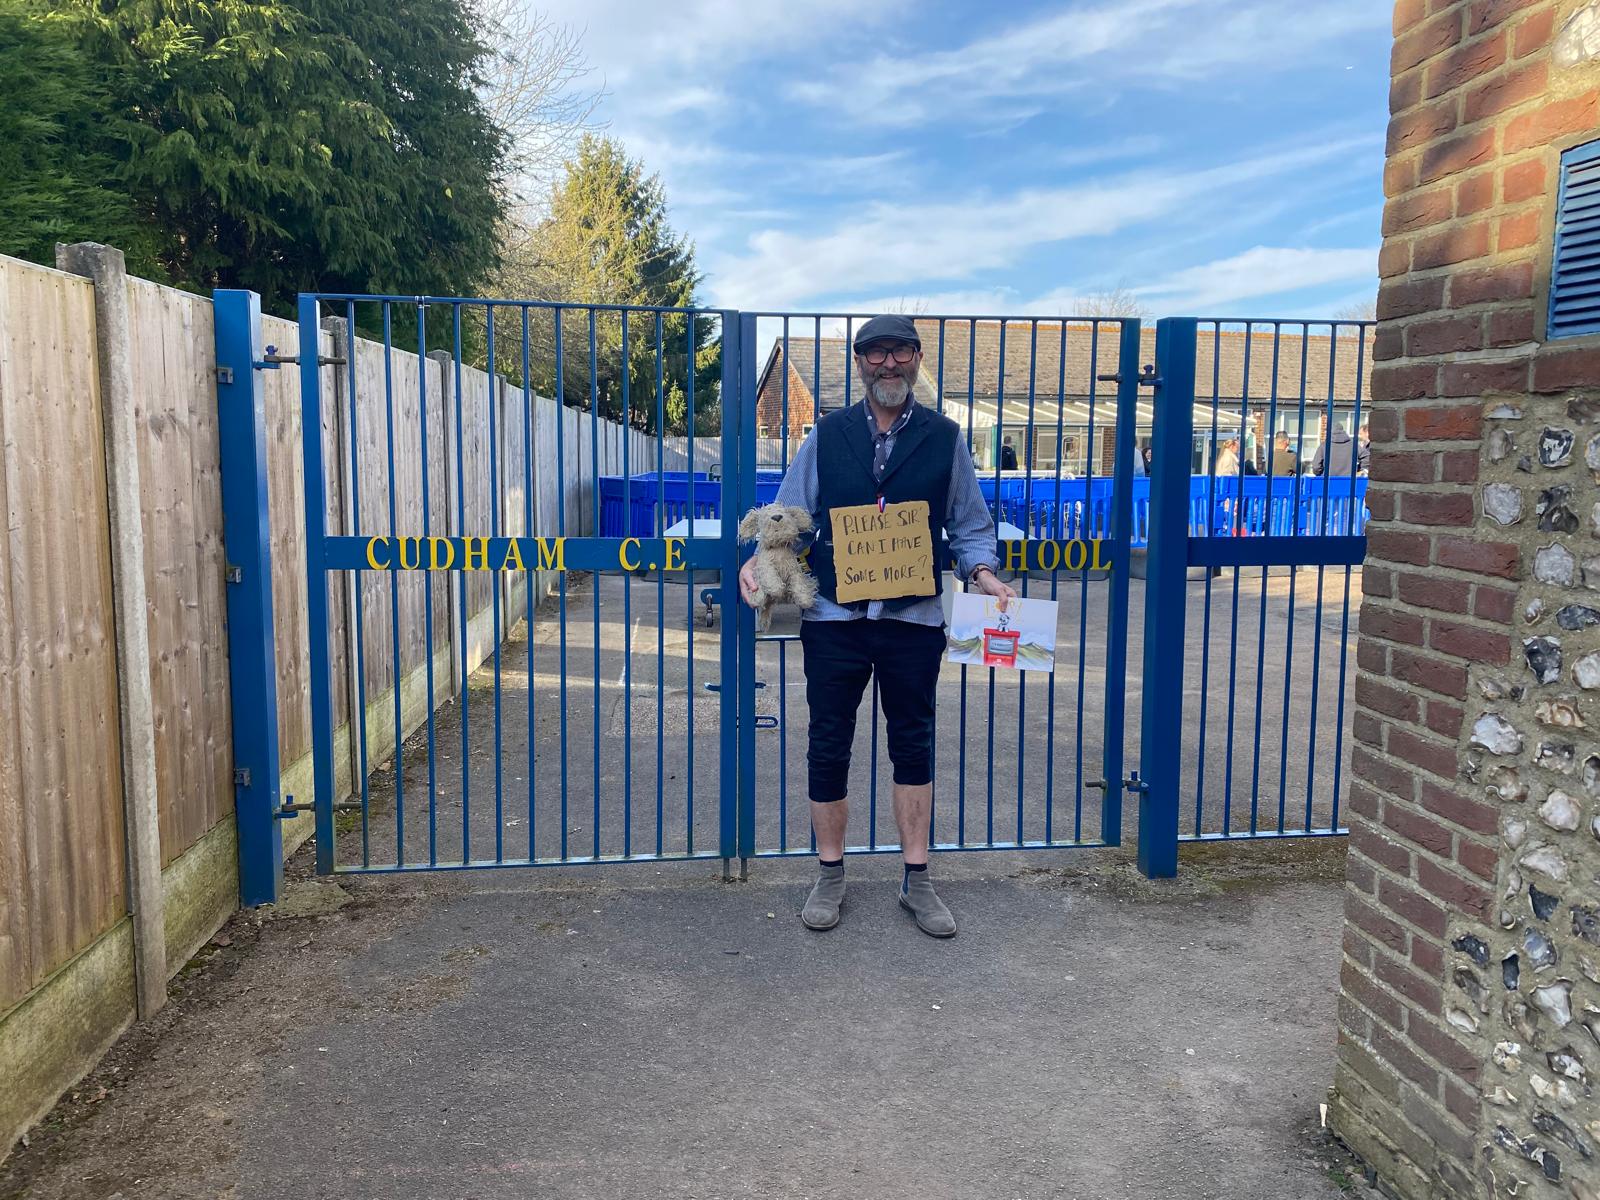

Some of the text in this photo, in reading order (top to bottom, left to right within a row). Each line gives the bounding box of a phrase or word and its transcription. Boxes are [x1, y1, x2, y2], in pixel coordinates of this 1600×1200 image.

[366, 537, 1112, 571] CUDHAM C.E HOOL
[847, 535, 922, 555] CAN I HAVE
